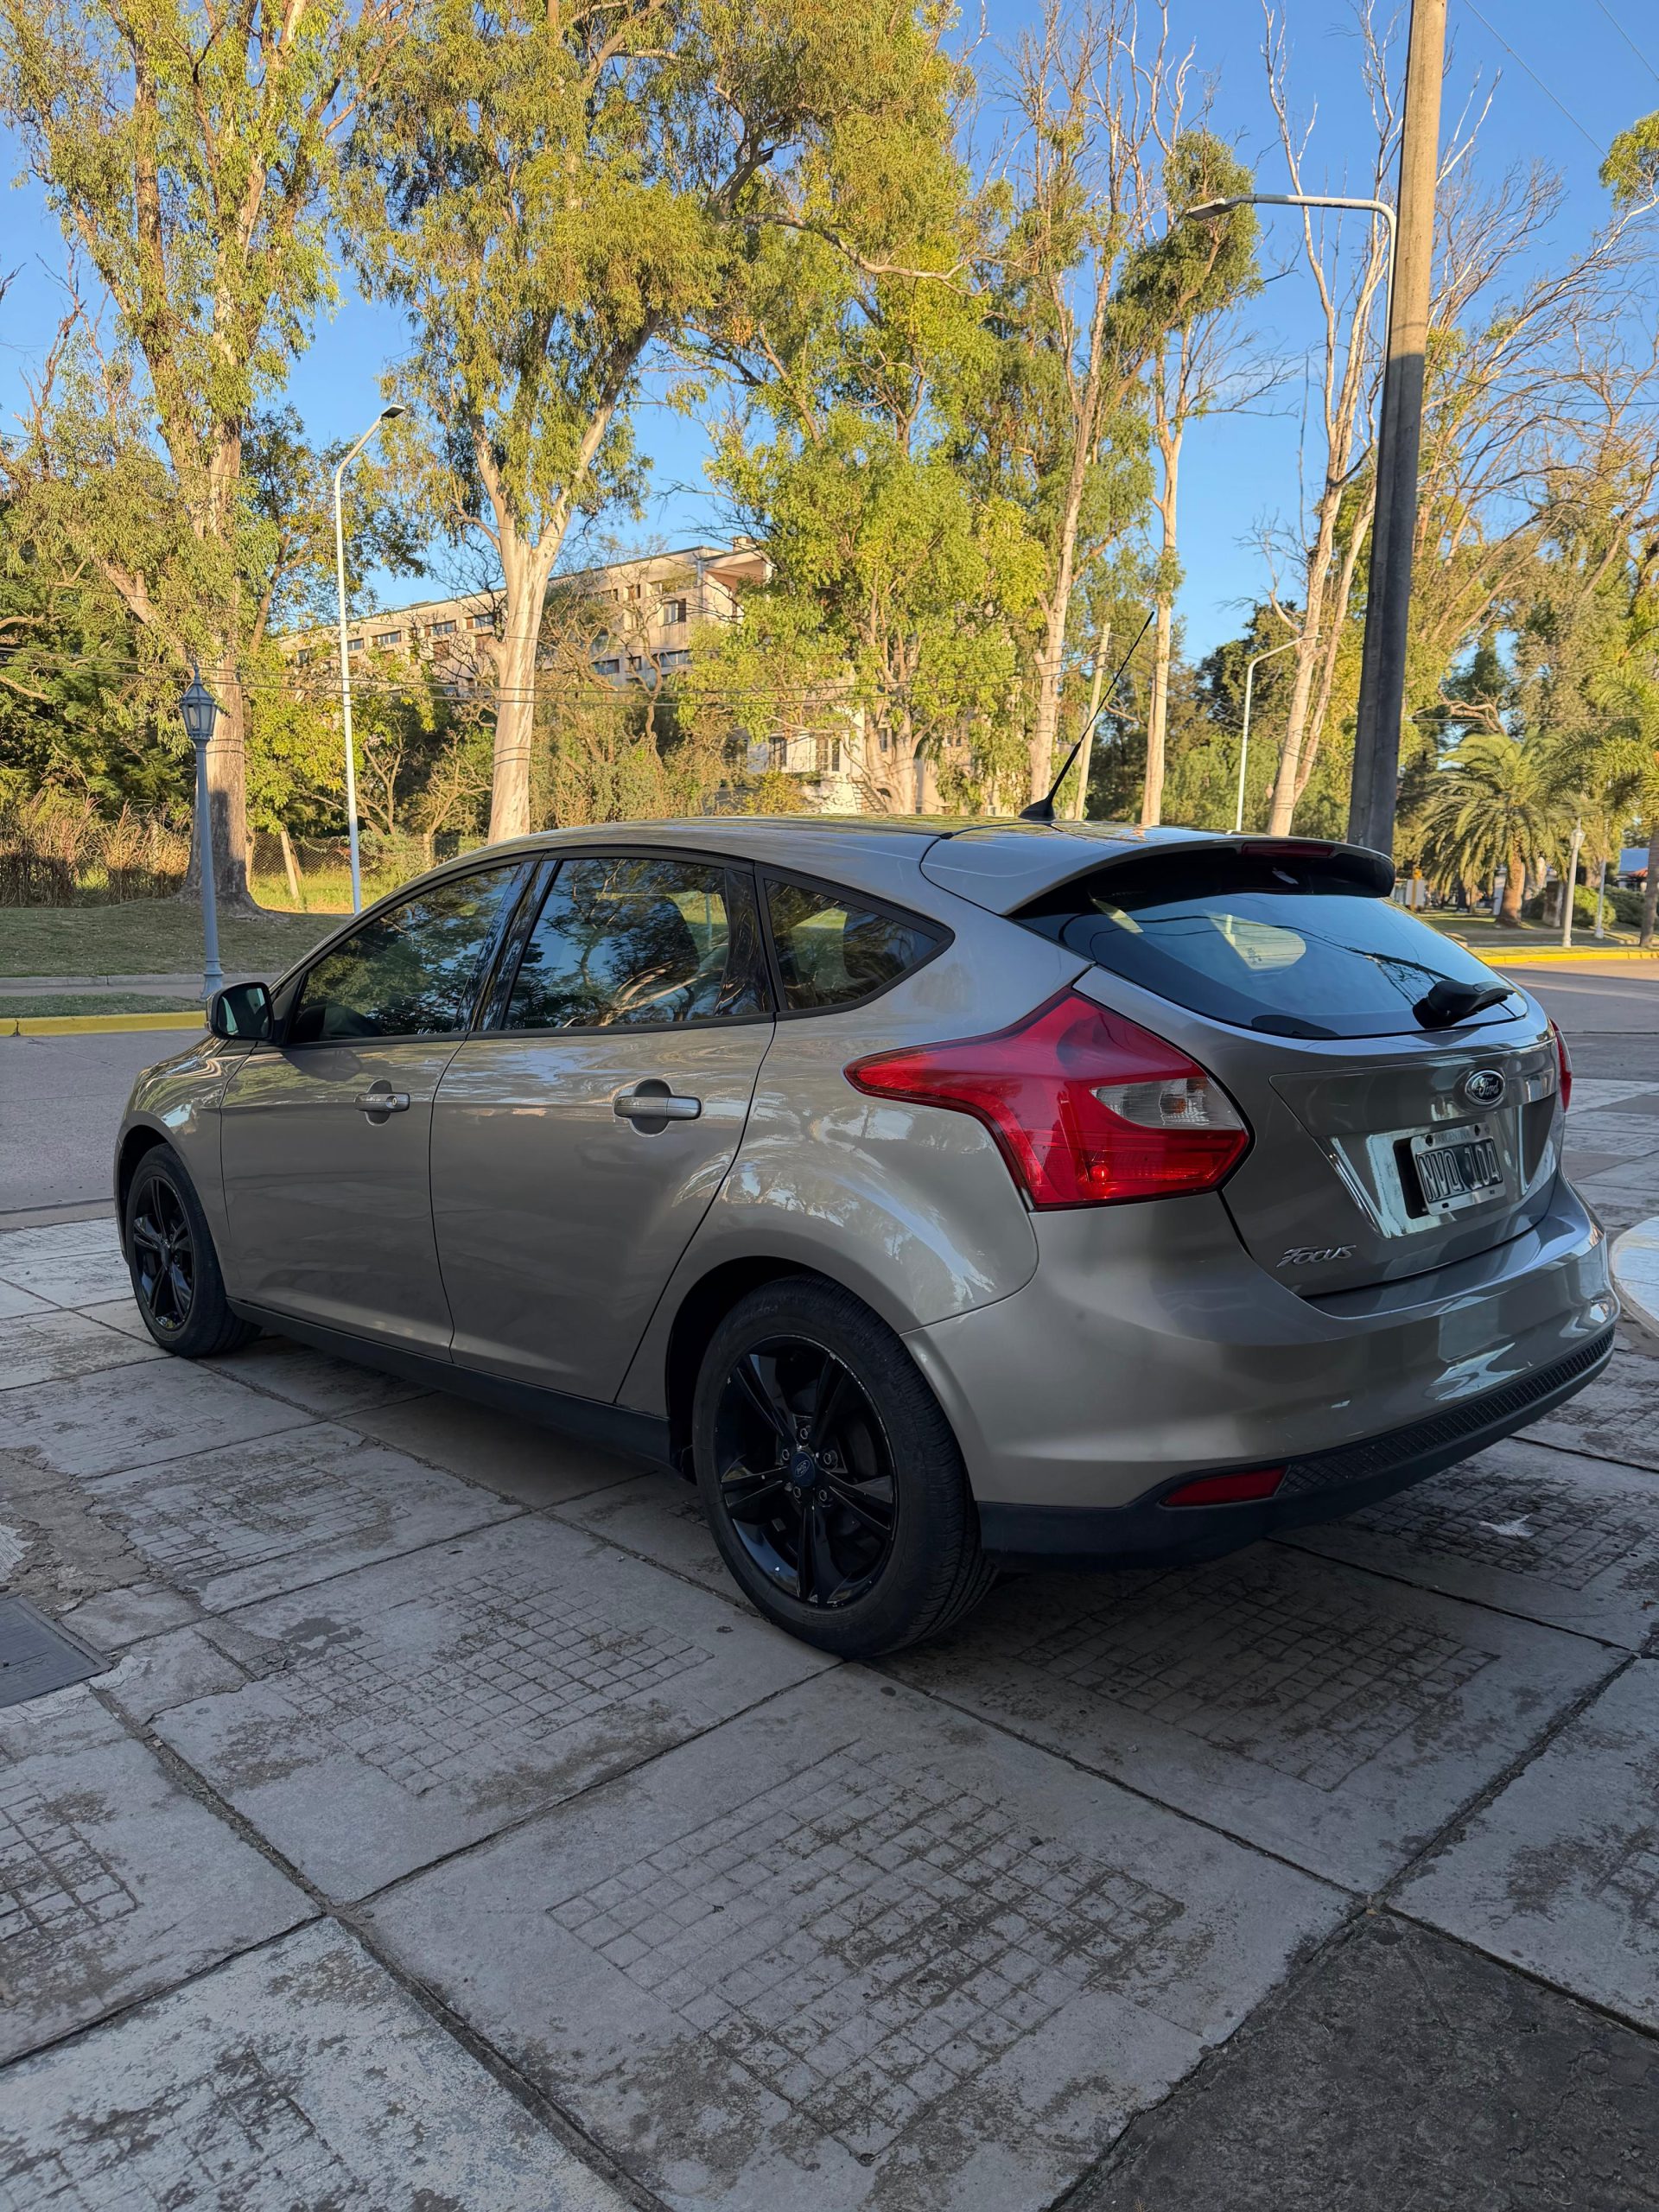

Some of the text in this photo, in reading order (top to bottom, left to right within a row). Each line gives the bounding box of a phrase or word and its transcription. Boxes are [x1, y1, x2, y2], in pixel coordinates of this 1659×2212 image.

[1471, 1077, 1499, 1097] Ford
[1419, 1142, 1503, 1200] NVQ 104
